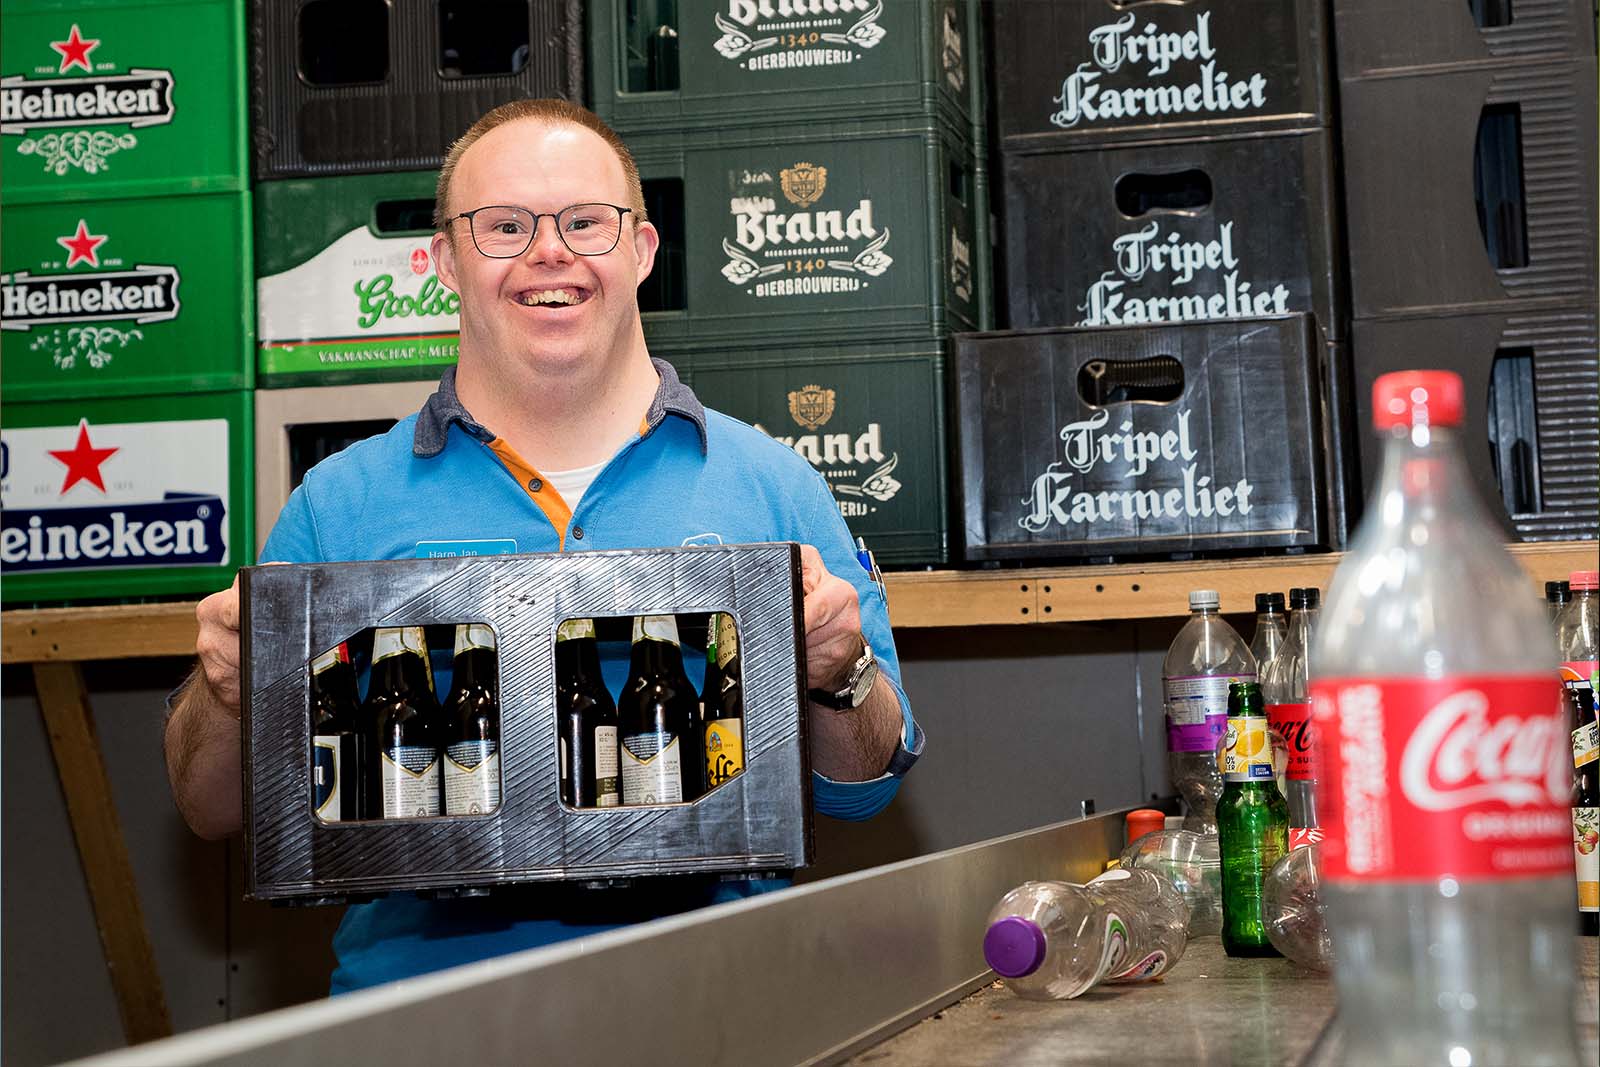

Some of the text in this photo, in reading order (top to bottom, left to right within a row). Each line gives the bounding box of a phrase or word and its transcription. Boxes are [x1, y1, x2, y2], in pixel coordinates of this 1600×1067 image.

[748, 50, 853, 71] BIERBROUWERIJ
[780, 32, 819, 48] 1340
[1089, 10, 1217, 76] Tripel
[0, 85, 160, 121] Heineken
[1050, 60, 1267, 128] Karmeliet
[731, 196, 877, 252] Brand
[786, 258, 825, 273] 1340
[1113, 220, 1239, 285] Tripel
[2, 281, 165, 317] Heineken
[354, 274, 460, 328] Grolsc
[756, 276, 860, 297] BIERBROUWERIJ
[1075, 270, 1290, 327] Karmeliet
[319, 347, 415, 363] VAKMANSCHAP
[1059, 408, 1198, 478] Tripel
[1018, 462, 1254, 532] Karmeliet
[0, 513, 208, 563] eineken
